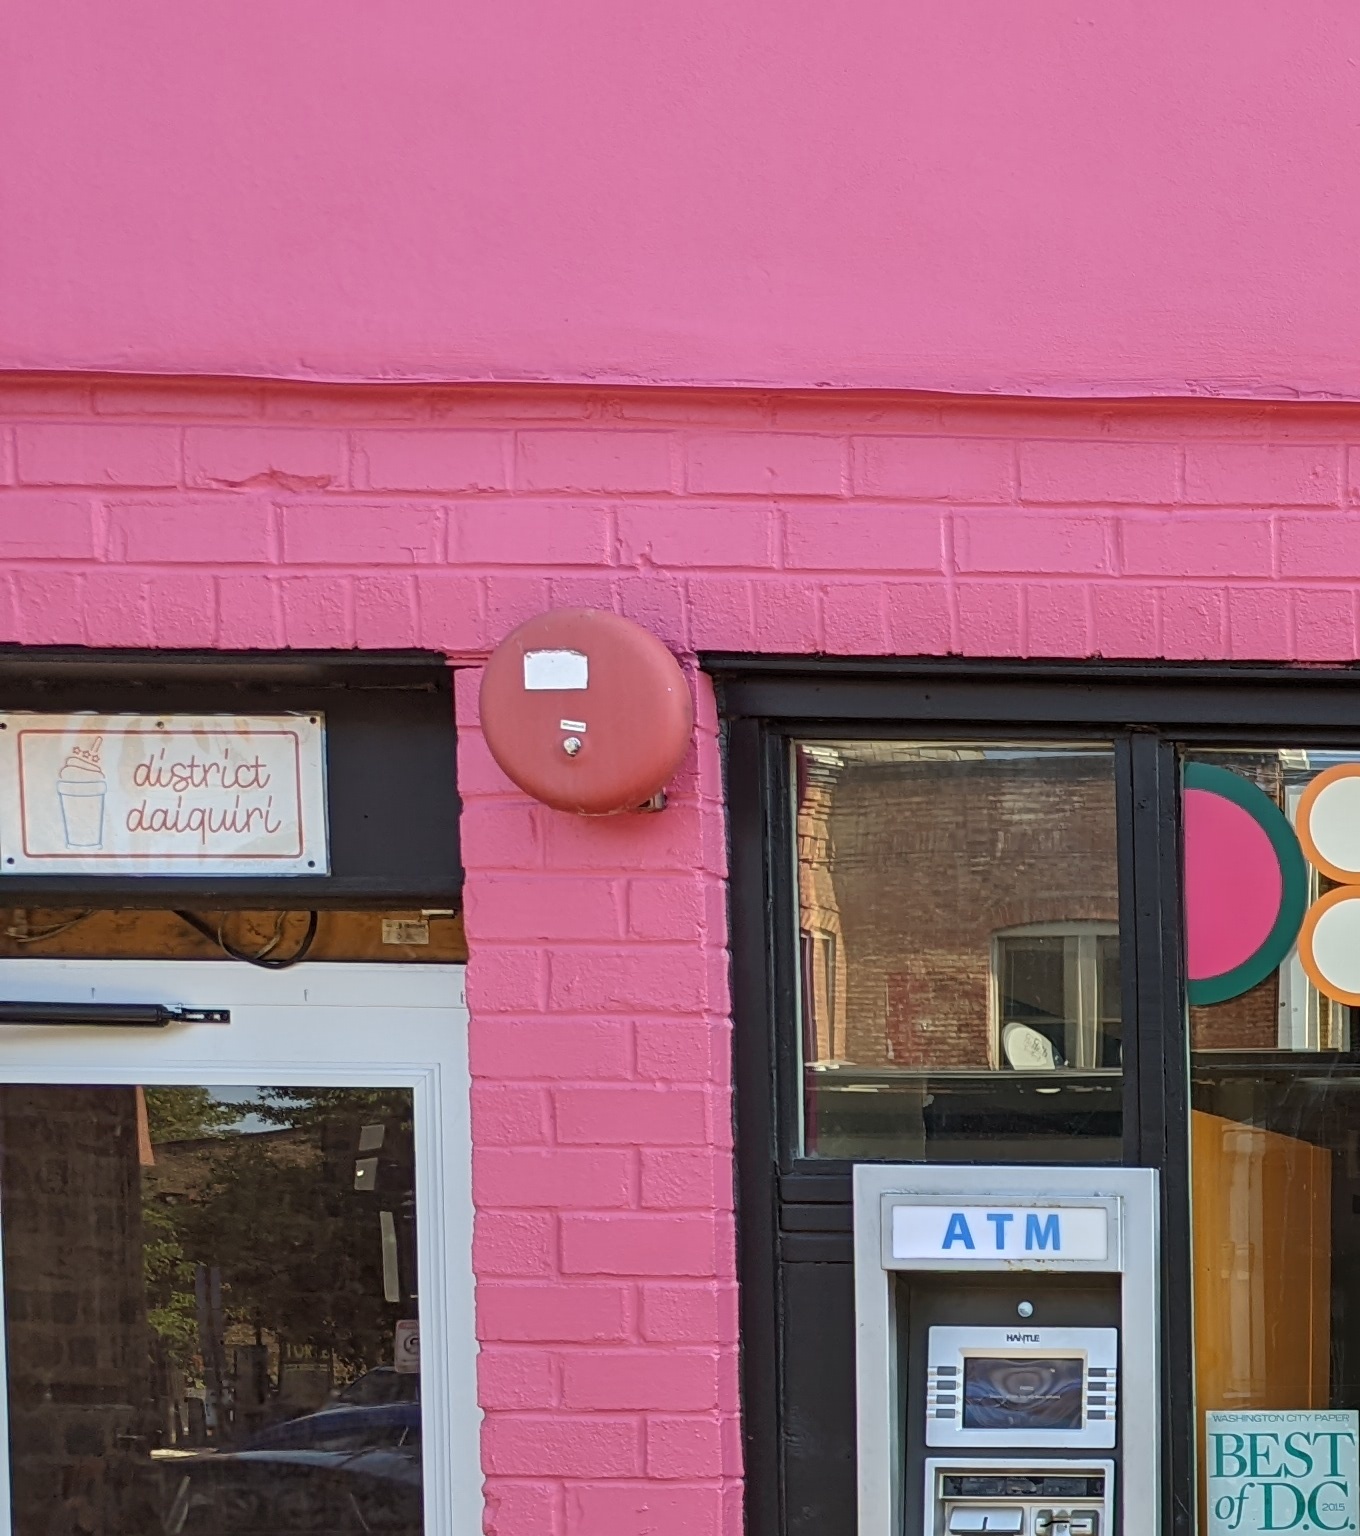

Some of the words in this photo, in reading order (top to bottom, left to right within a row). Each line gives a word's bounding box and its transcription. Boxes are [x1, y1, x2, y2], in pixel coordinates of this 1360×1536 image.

[133, 748, 271, 792] district
[126, 794, 282, 845] daiquiri
[942, 1212, 1062, 1251] ATM
[1212, 1414, 1285, 1422] WASHINGTON
[1287, 1414, 1312, 1422] CITY
[1314, 1414, 1350, 1422] PAPER
[1209, 1431, 1356, 1478] BEST
[1215, 1482, 1255, 1530] of
[1257, 1481, 1356, 1531] D.C.
[1322, 1503, 1345, 1512] 2015
